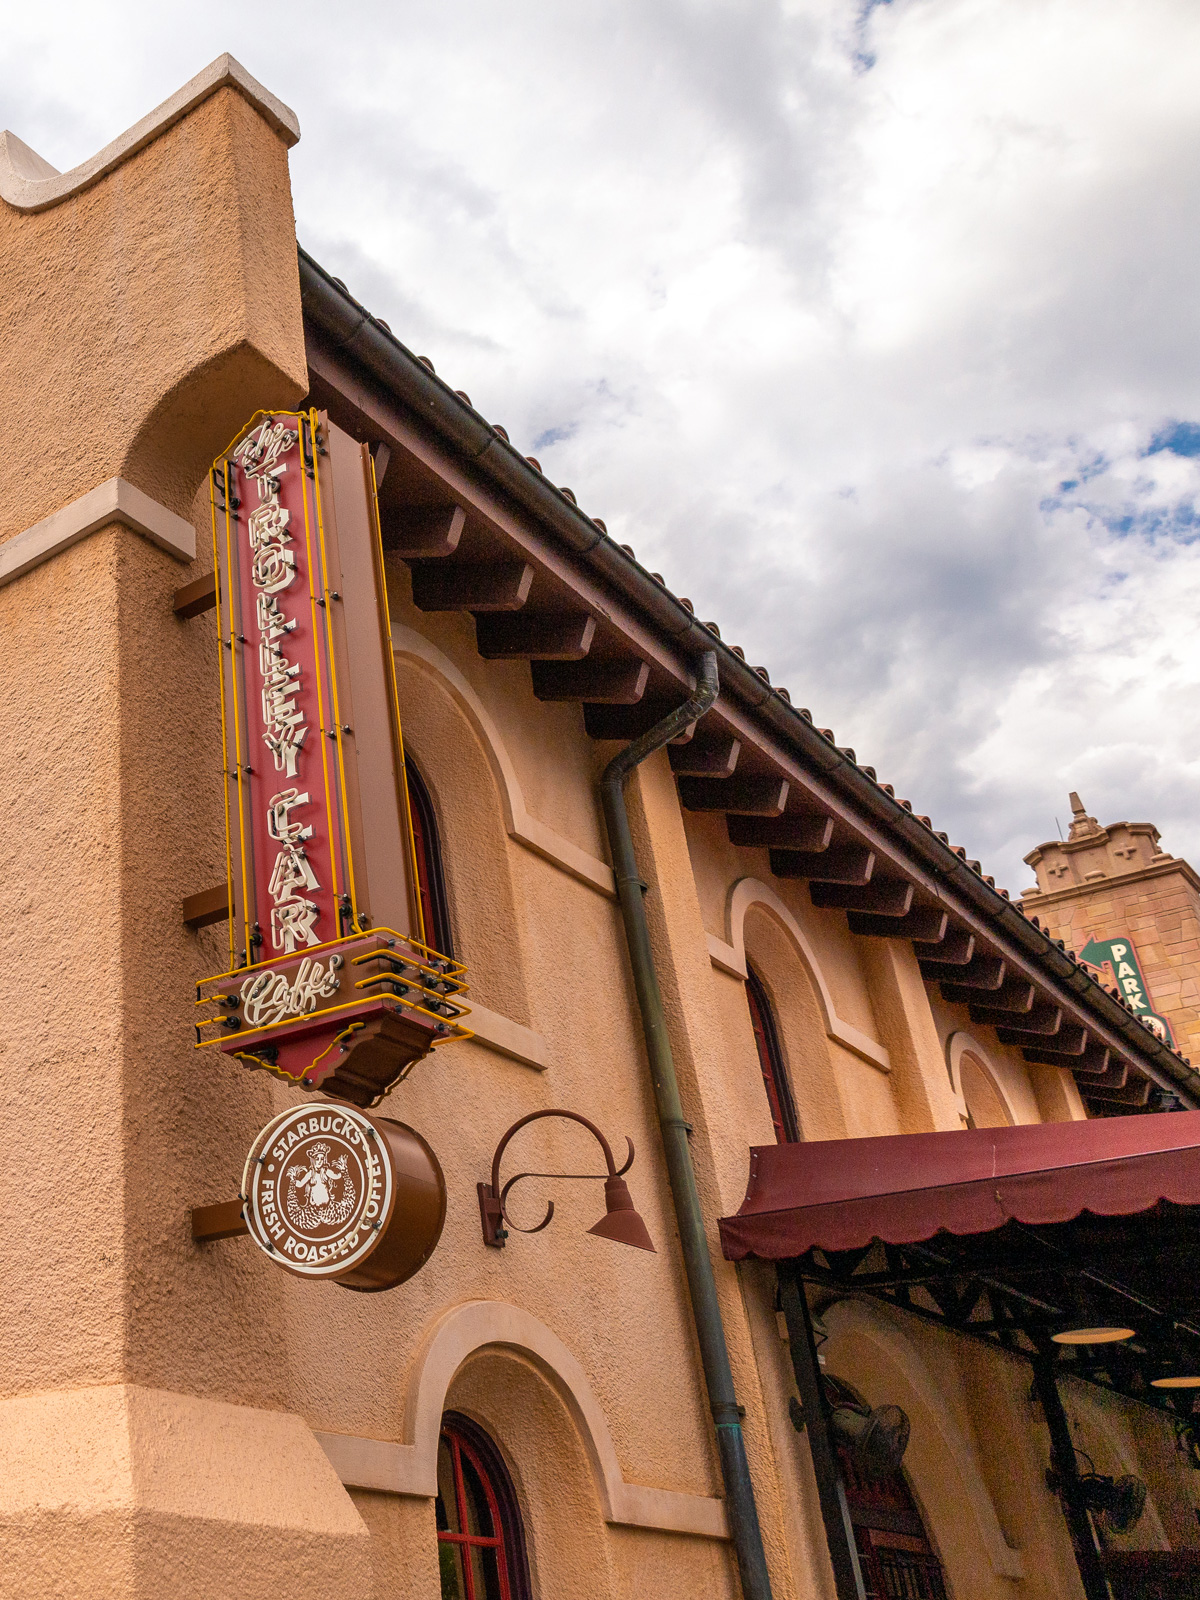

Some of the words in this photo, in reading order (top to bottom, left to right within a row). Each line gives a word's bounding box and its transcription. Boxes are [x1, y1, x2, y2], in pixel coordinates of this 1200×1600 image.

[246, 457, 308, 778] TROLLEY
[267, 787, 322, 954] CAR
[1110, 944, 1148, 1010] PARK
[273, 1116, 361, 1161] STARBUCKS
[261, 1179, 286, 1241] FRESH
[283, 1230, 360, 1262] ROASTED
